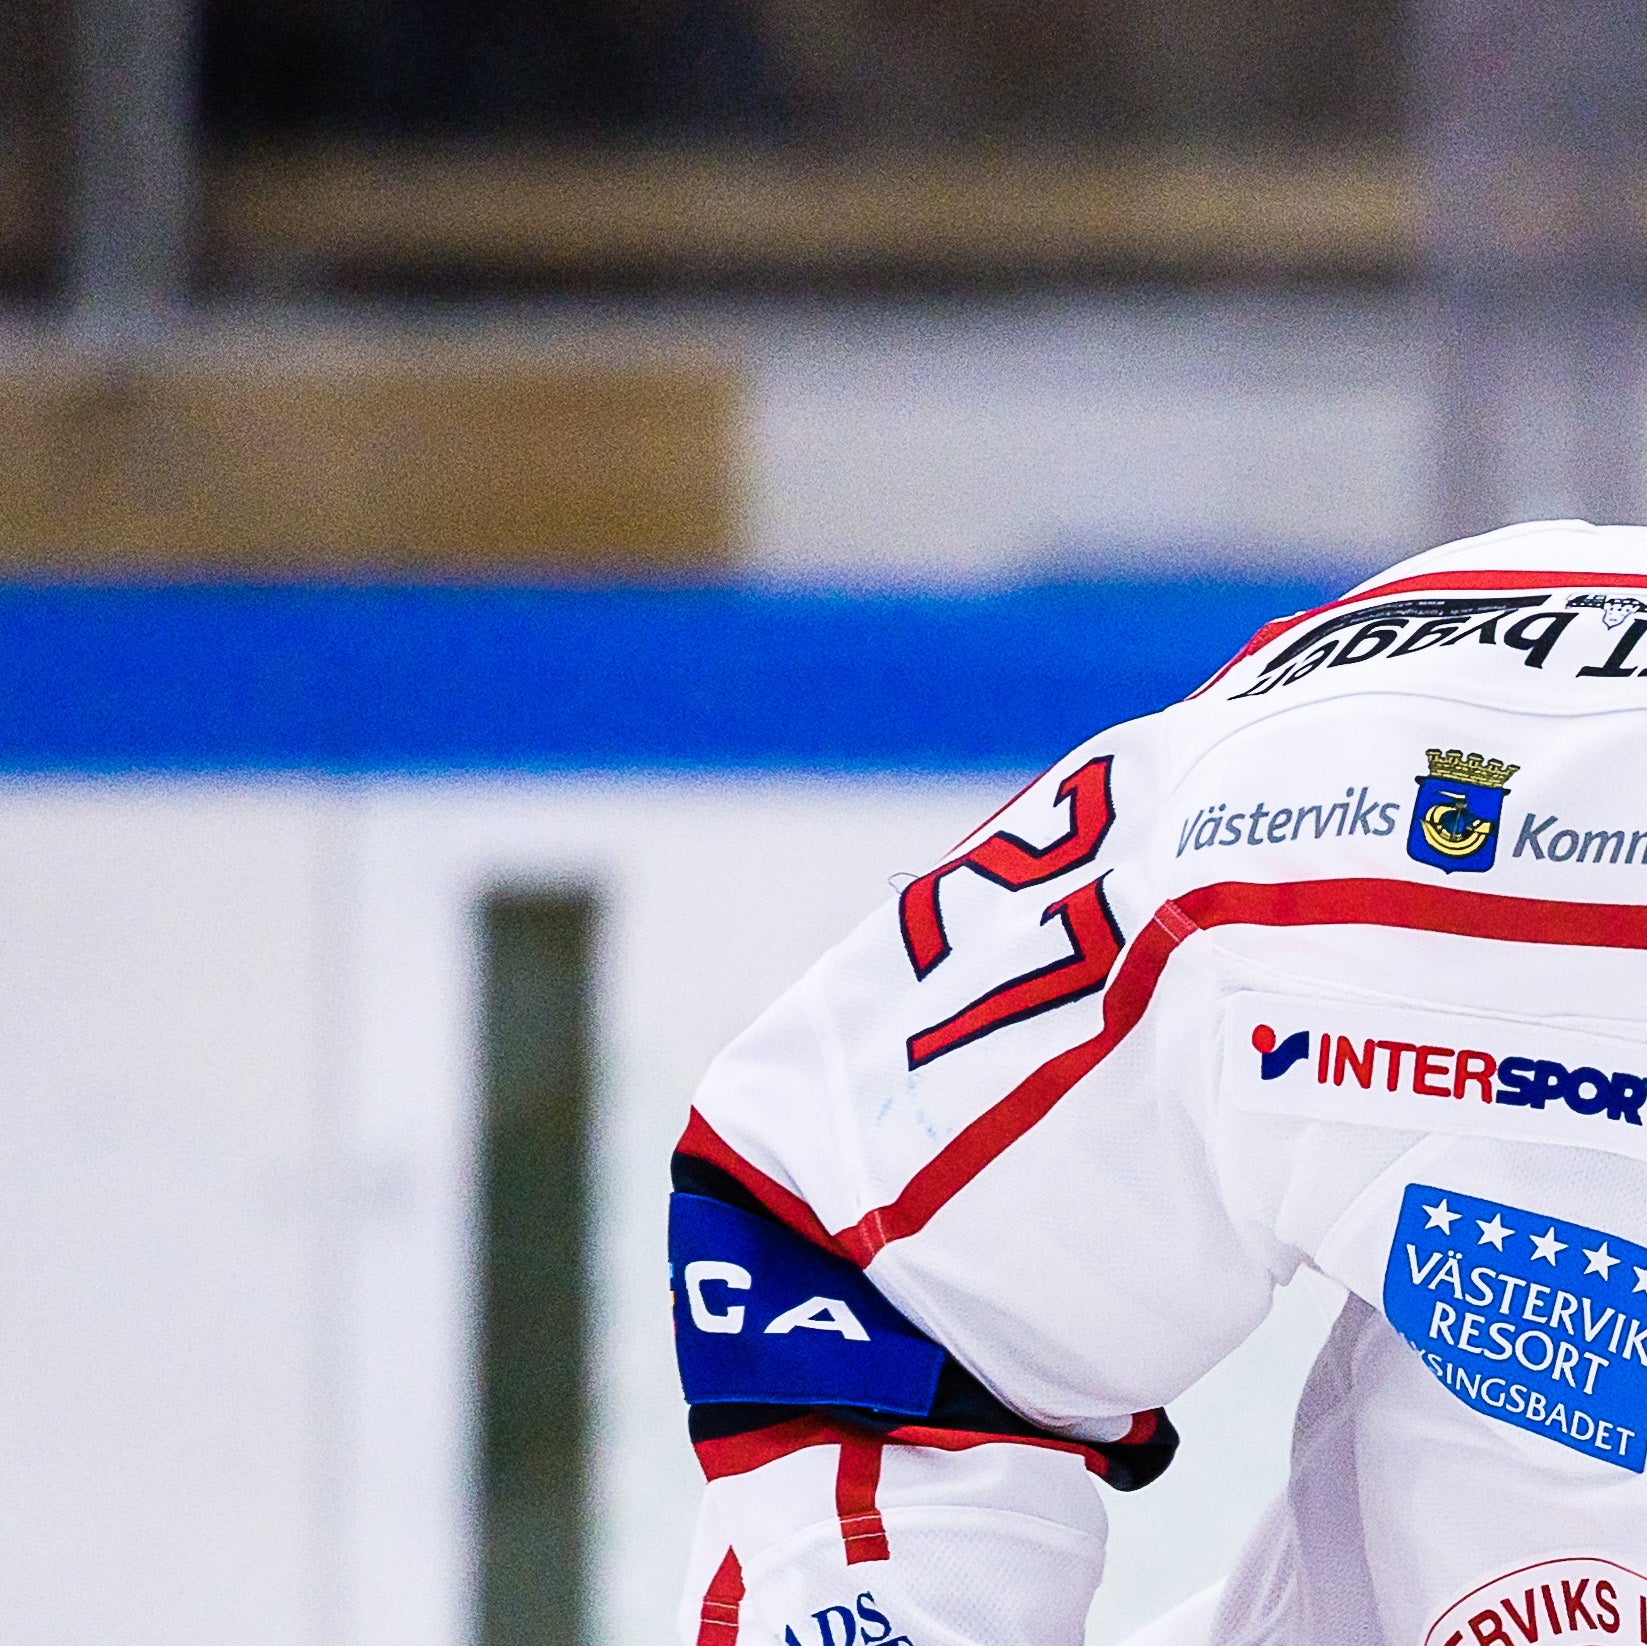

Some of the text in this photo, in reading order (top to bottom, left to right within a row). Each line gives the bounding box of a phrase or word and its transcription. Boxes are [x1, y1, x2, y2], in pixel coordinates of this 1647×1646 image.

[1177, 786, 1401, 859] Västerviks
[898, 754, 1126, 1073] 27
[1400, 1332, 1636, 1457] SINGSBADET
[1429, 1300, 1610, 1396] RESORT
